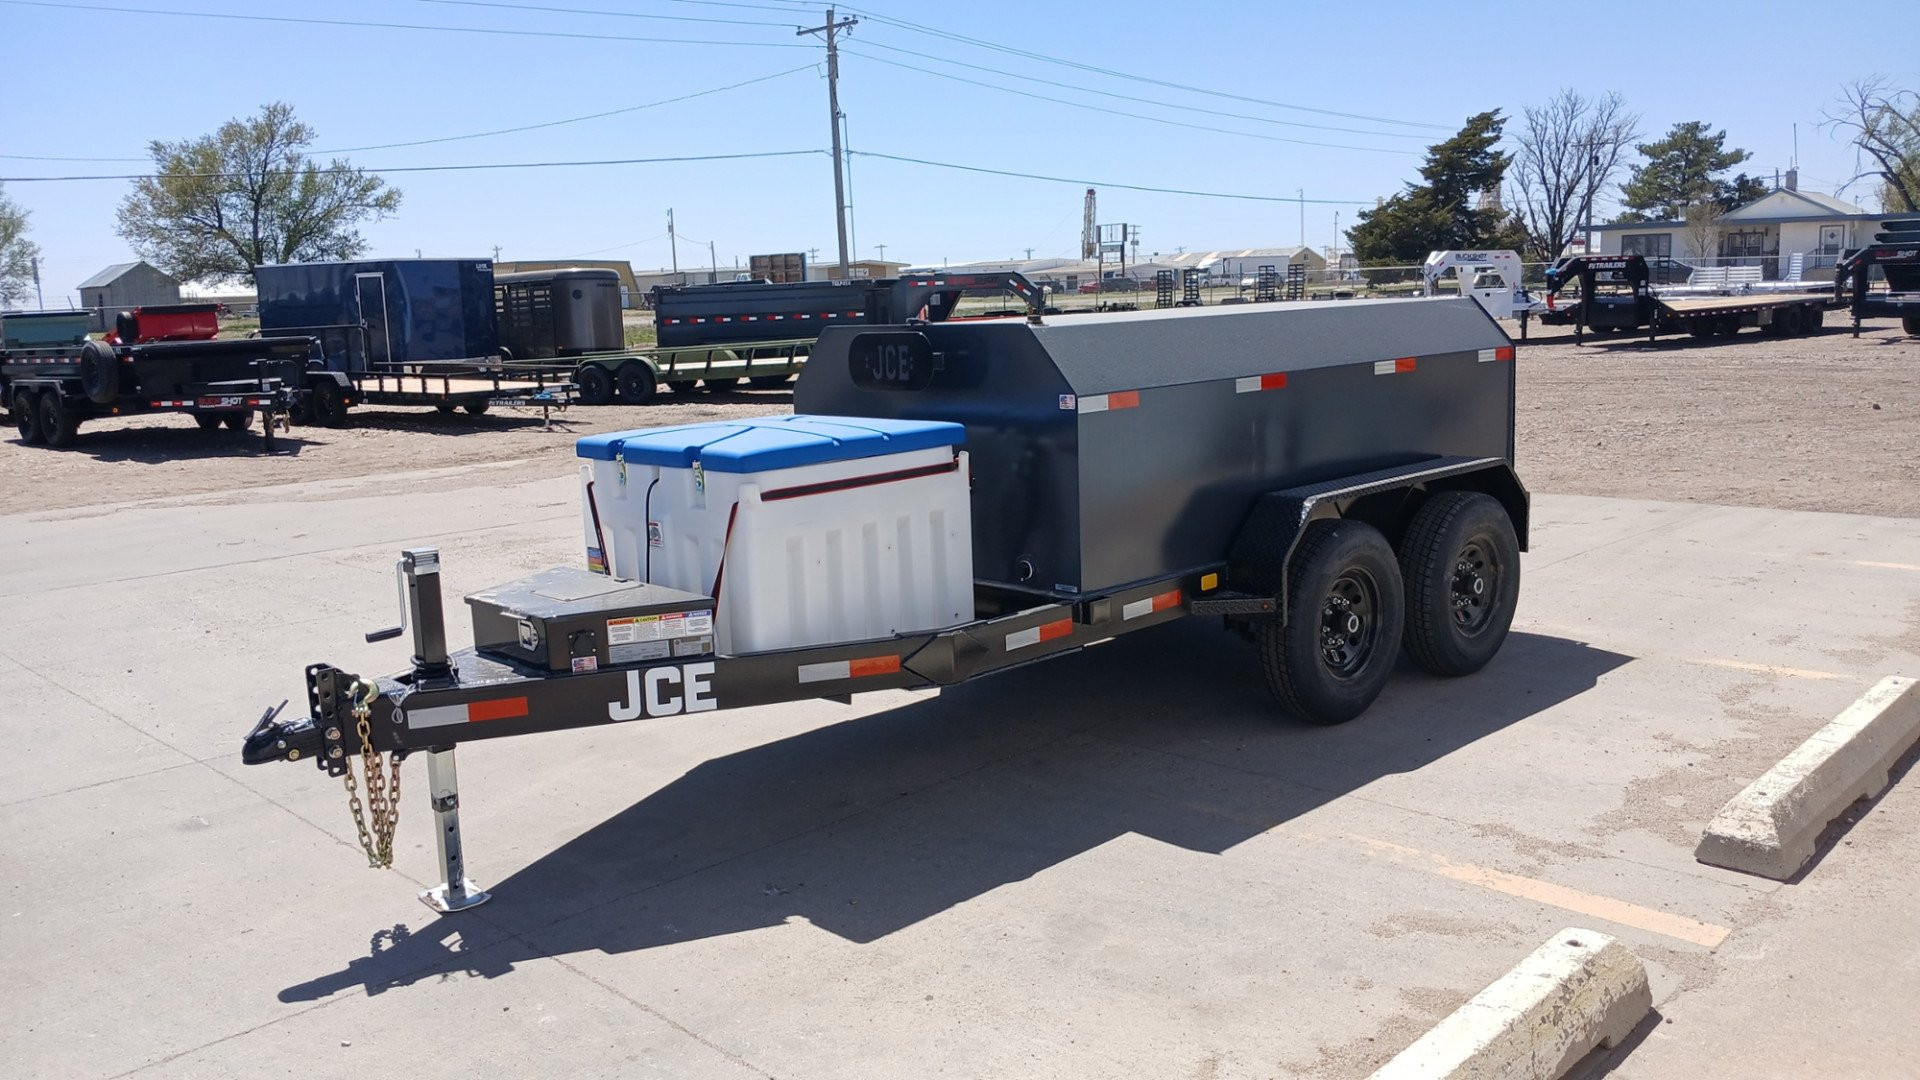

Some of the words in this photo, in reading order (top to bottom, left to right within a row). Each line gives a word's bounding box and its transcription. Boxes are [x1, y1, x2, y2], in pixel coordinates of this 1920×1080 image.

[1596, 261, 1626, 269] TRAILERS
[872, 344, 910, 380] JCE
[608, 661, 717, 721] JCE
